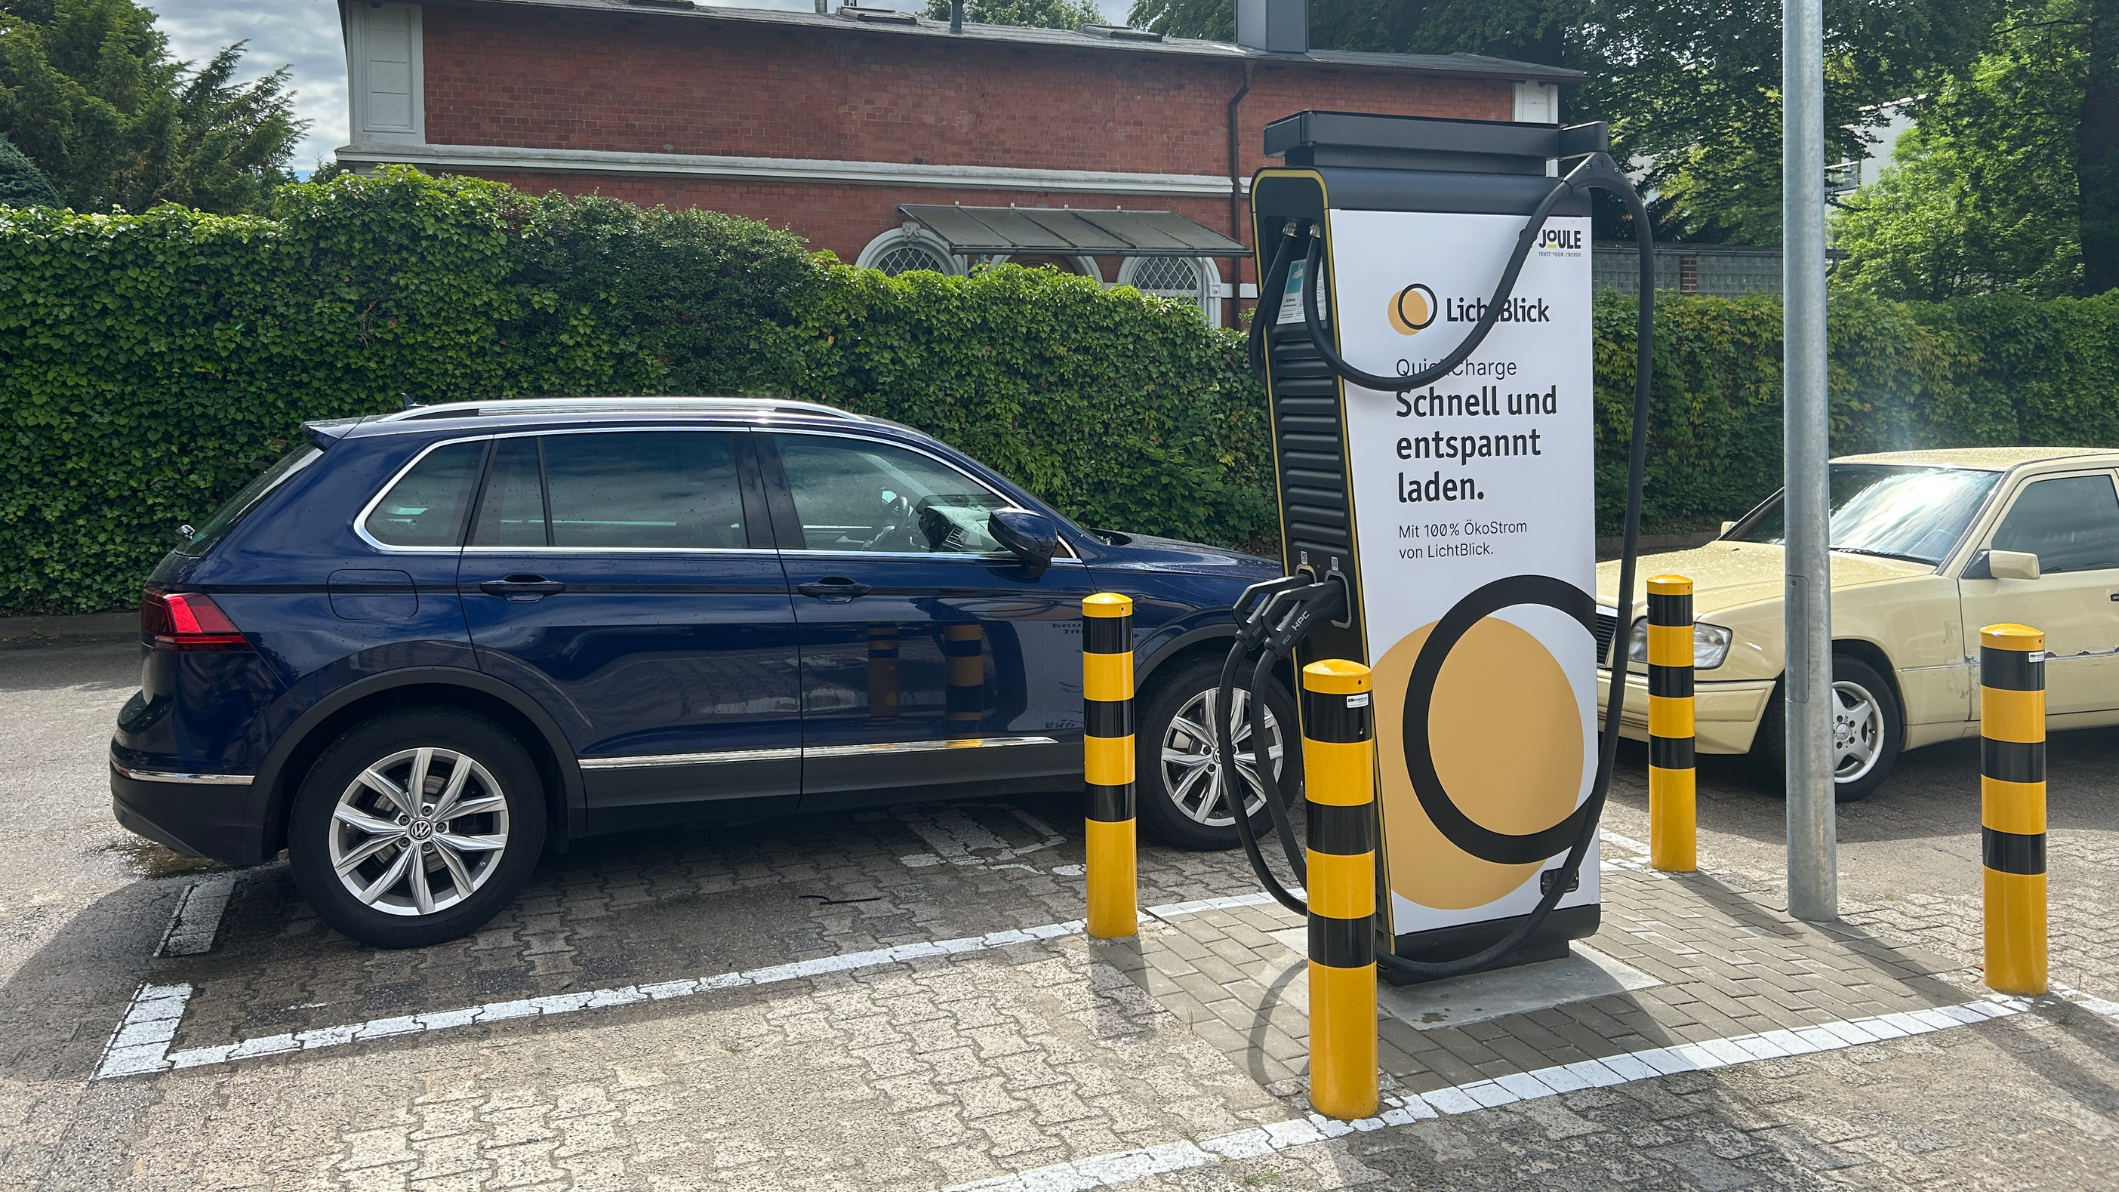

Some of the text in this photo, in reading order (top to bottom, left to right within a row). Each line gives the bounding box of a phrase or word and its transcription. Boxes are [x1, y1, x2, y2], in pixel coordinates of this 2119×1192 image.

[1538, 229, 1582, 249] JOULE
[1446, 297, 1550, 322] LichBlick
[1396, 358, 1517, 380] QuiCharge
[1396, 385, 1557, 417] Schnell und
[1396, 428, 1541, 466] entspannt
[1398, 470, 1485, 503] laden.
[1399, 524, 1420, 538] Mit
[1464, 519, 1527, 535] ÖkoStrom
[1399, 542, 1494, 559] von LichtBlick.
[1291, 611, 1310, 631] HPC
